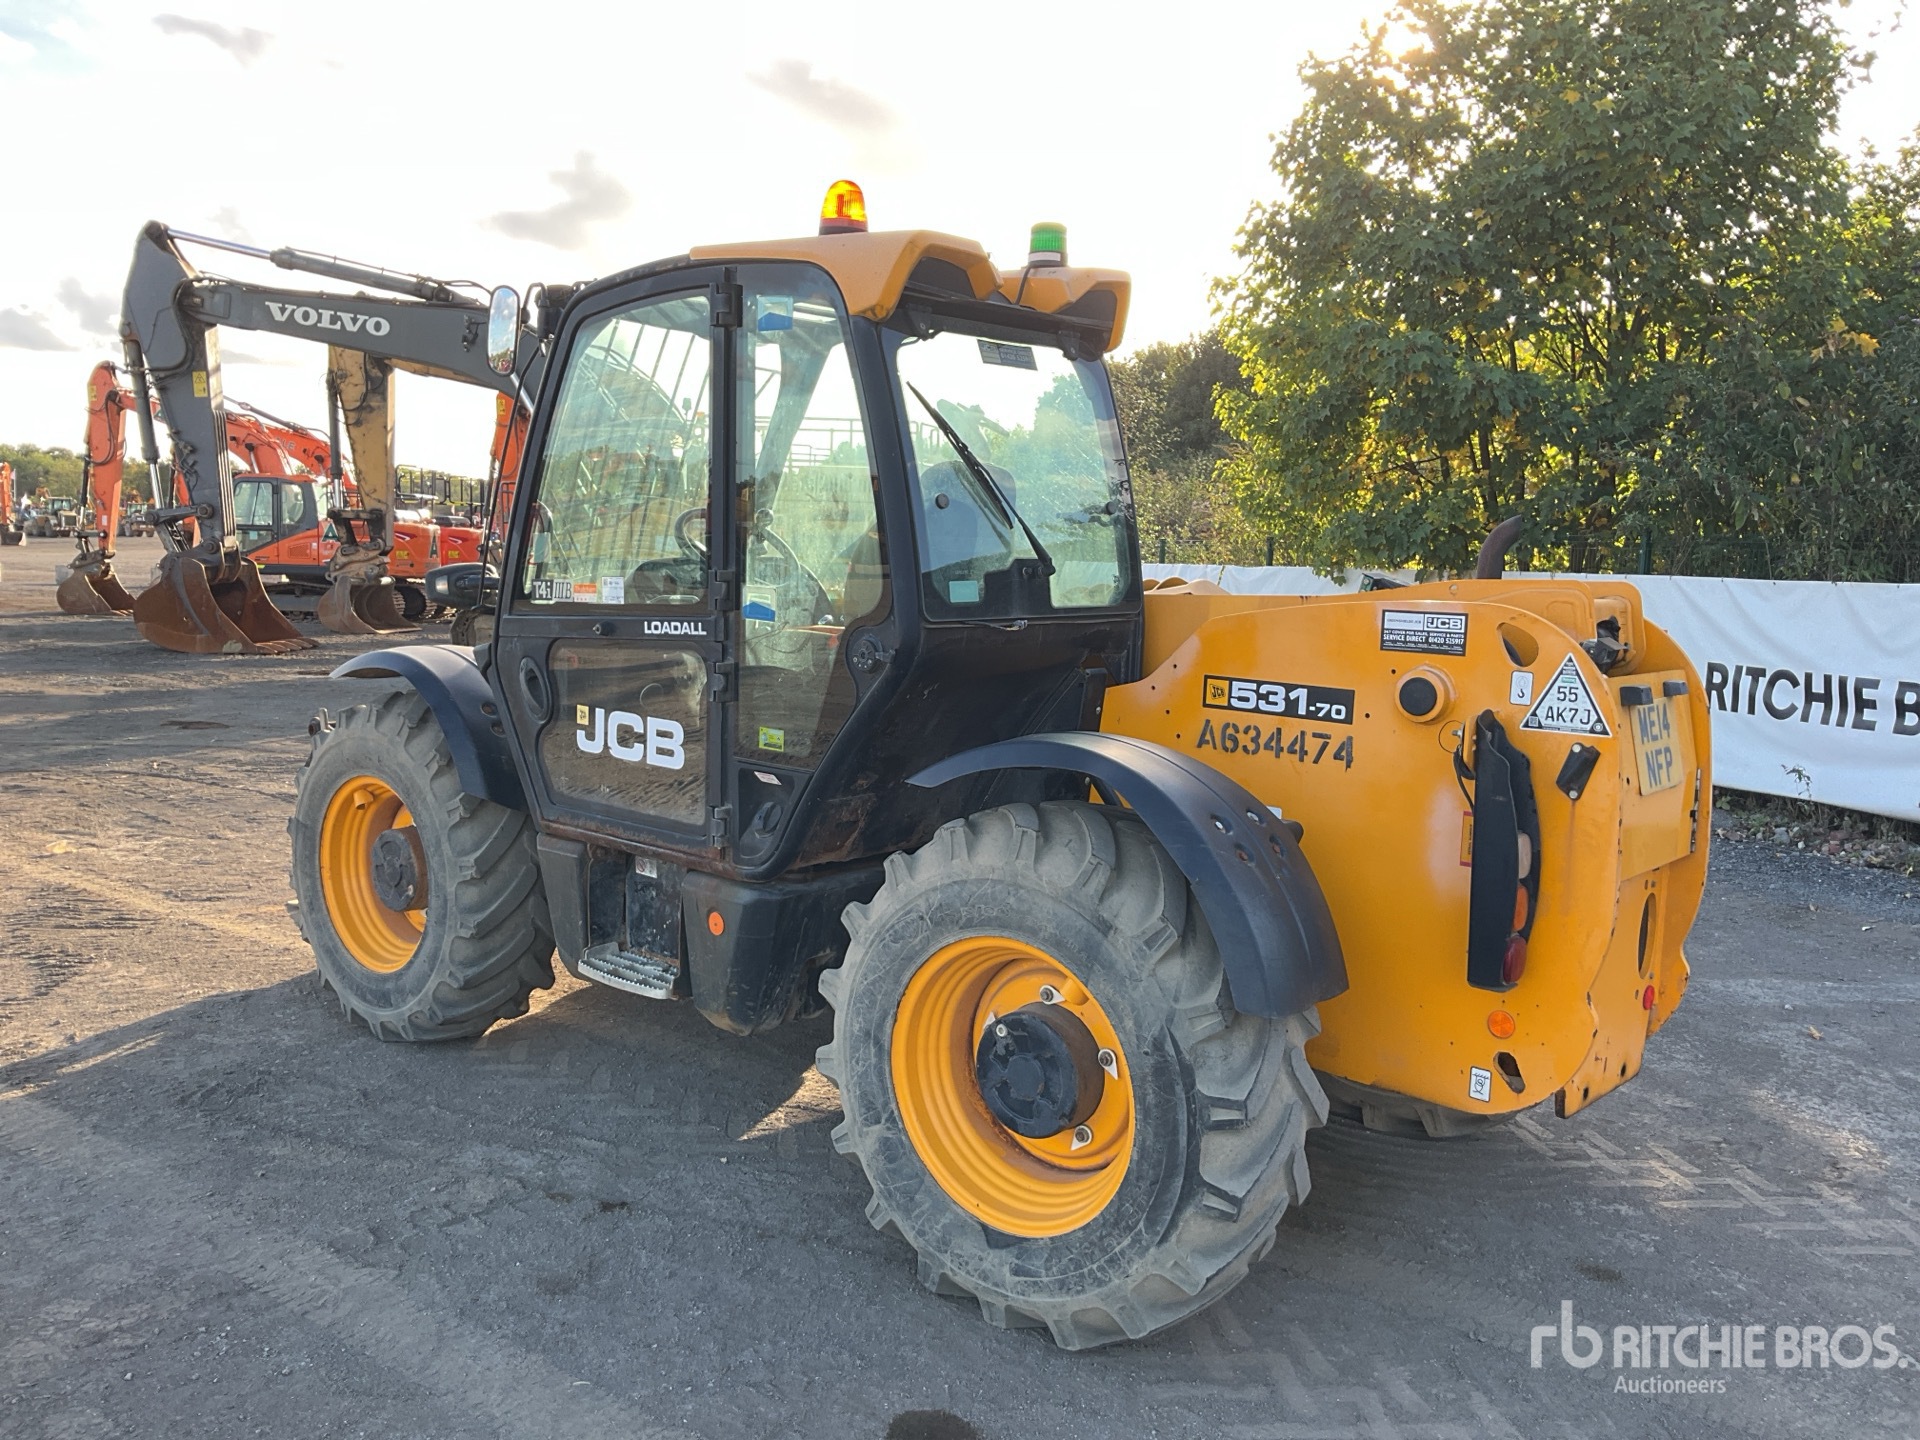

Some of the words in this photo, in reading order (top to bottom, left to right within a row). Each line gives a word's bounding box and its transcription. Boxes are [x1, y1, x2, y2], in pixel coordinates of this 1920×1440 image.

[265, 301, 390, 336] VOLVO
[532, 581, 552, 599] T4i
[644, 621, 707, 635] LOADALL
[1427, 617, 1462, 629] JCB
[1209, 684, 1227, 699] JCB
[1230, 681, 1347, 720] 531-70
[1557, 686, 1579, 702] 55
[1705, 661, 1881, 731] RITCHIE
[1892, 680, 1920, 736] B
[1545, 706, 1591, 725] AK7J
[576, 704, 685, 770] JCB
[1196, 719, 1354, 772] A634474
[1645, 746, 1672, 788] NFP
